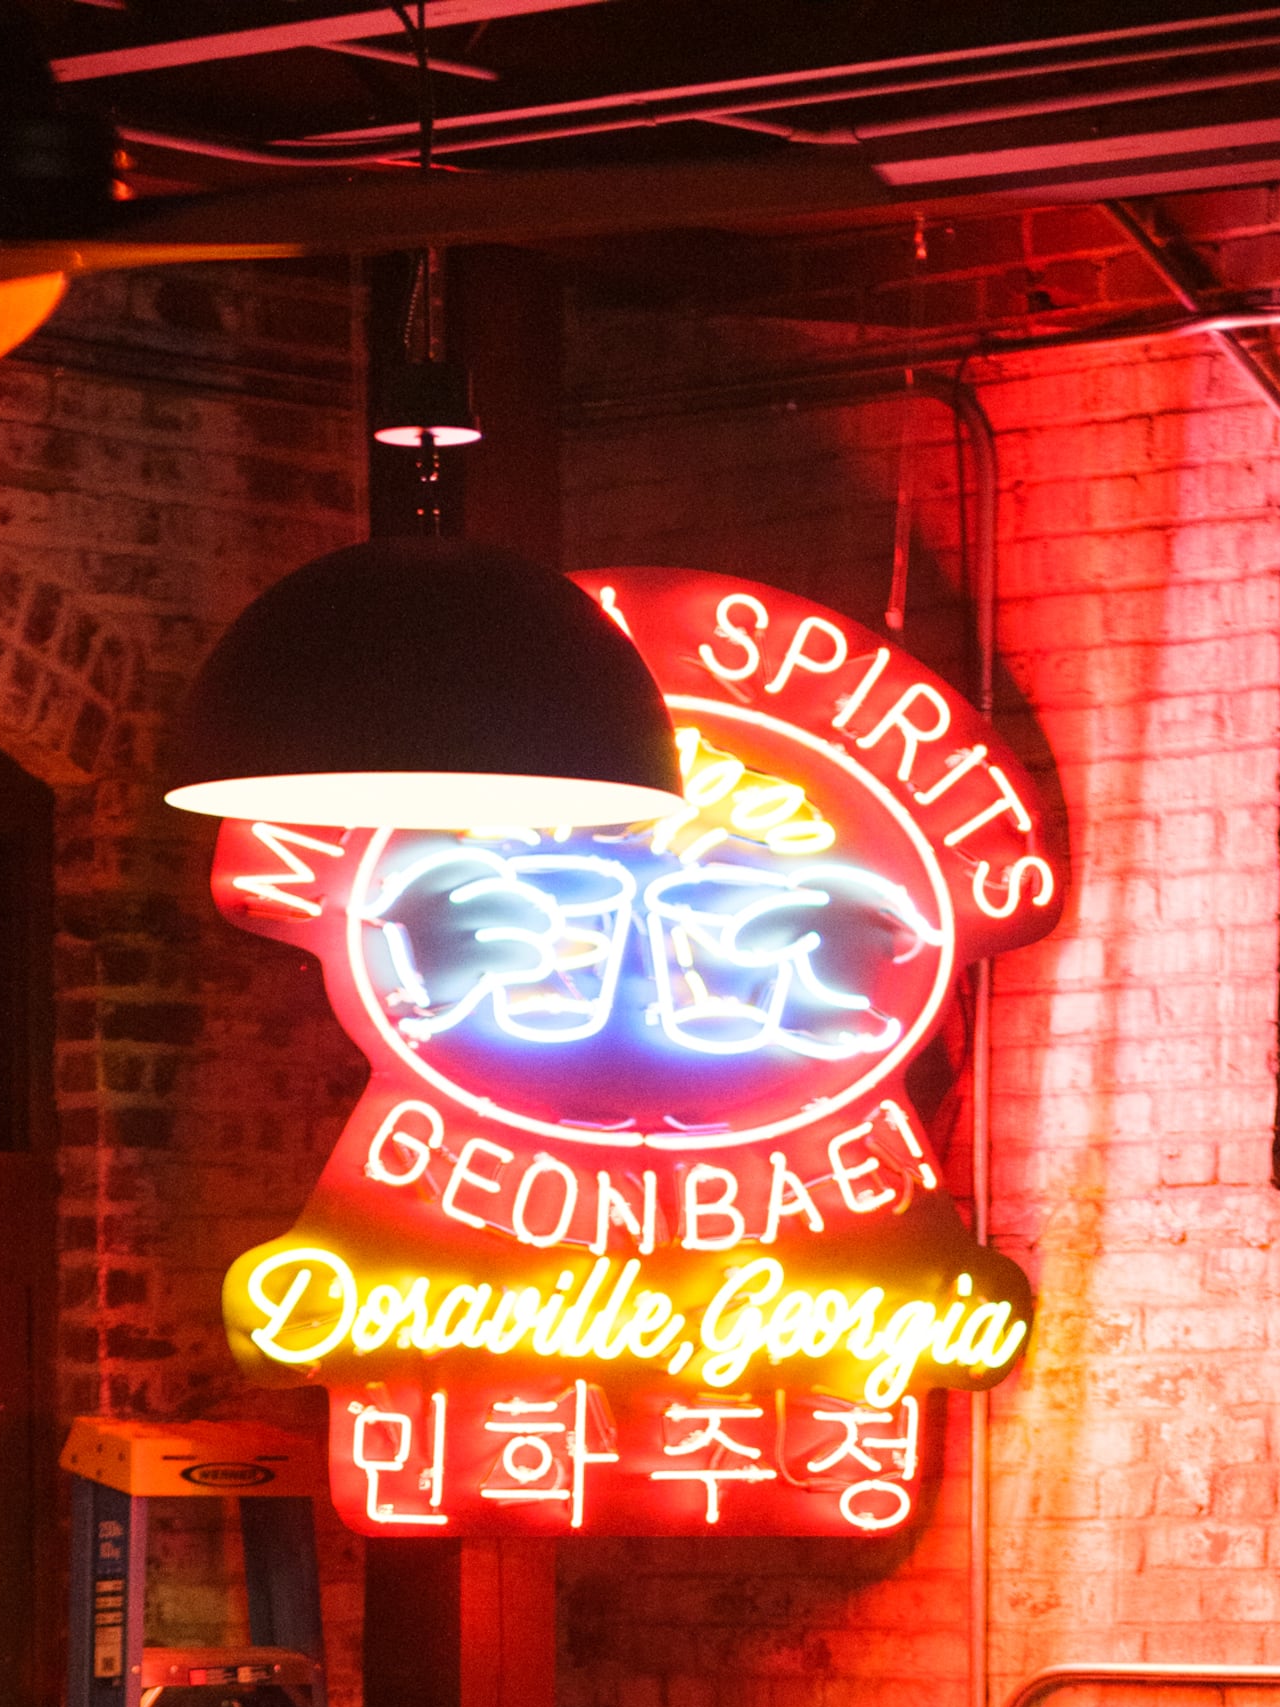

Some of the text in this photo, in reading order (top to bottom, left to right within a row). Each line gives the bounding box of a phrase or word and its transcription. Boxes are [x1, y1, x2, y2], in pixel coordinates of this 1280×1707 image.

[699, 594, 1054, 919] SPIRITS
[365, 1099, 937, 1254] GEONBAE!
[246, 1246, 1028, 1409] Doraville, Georgia
